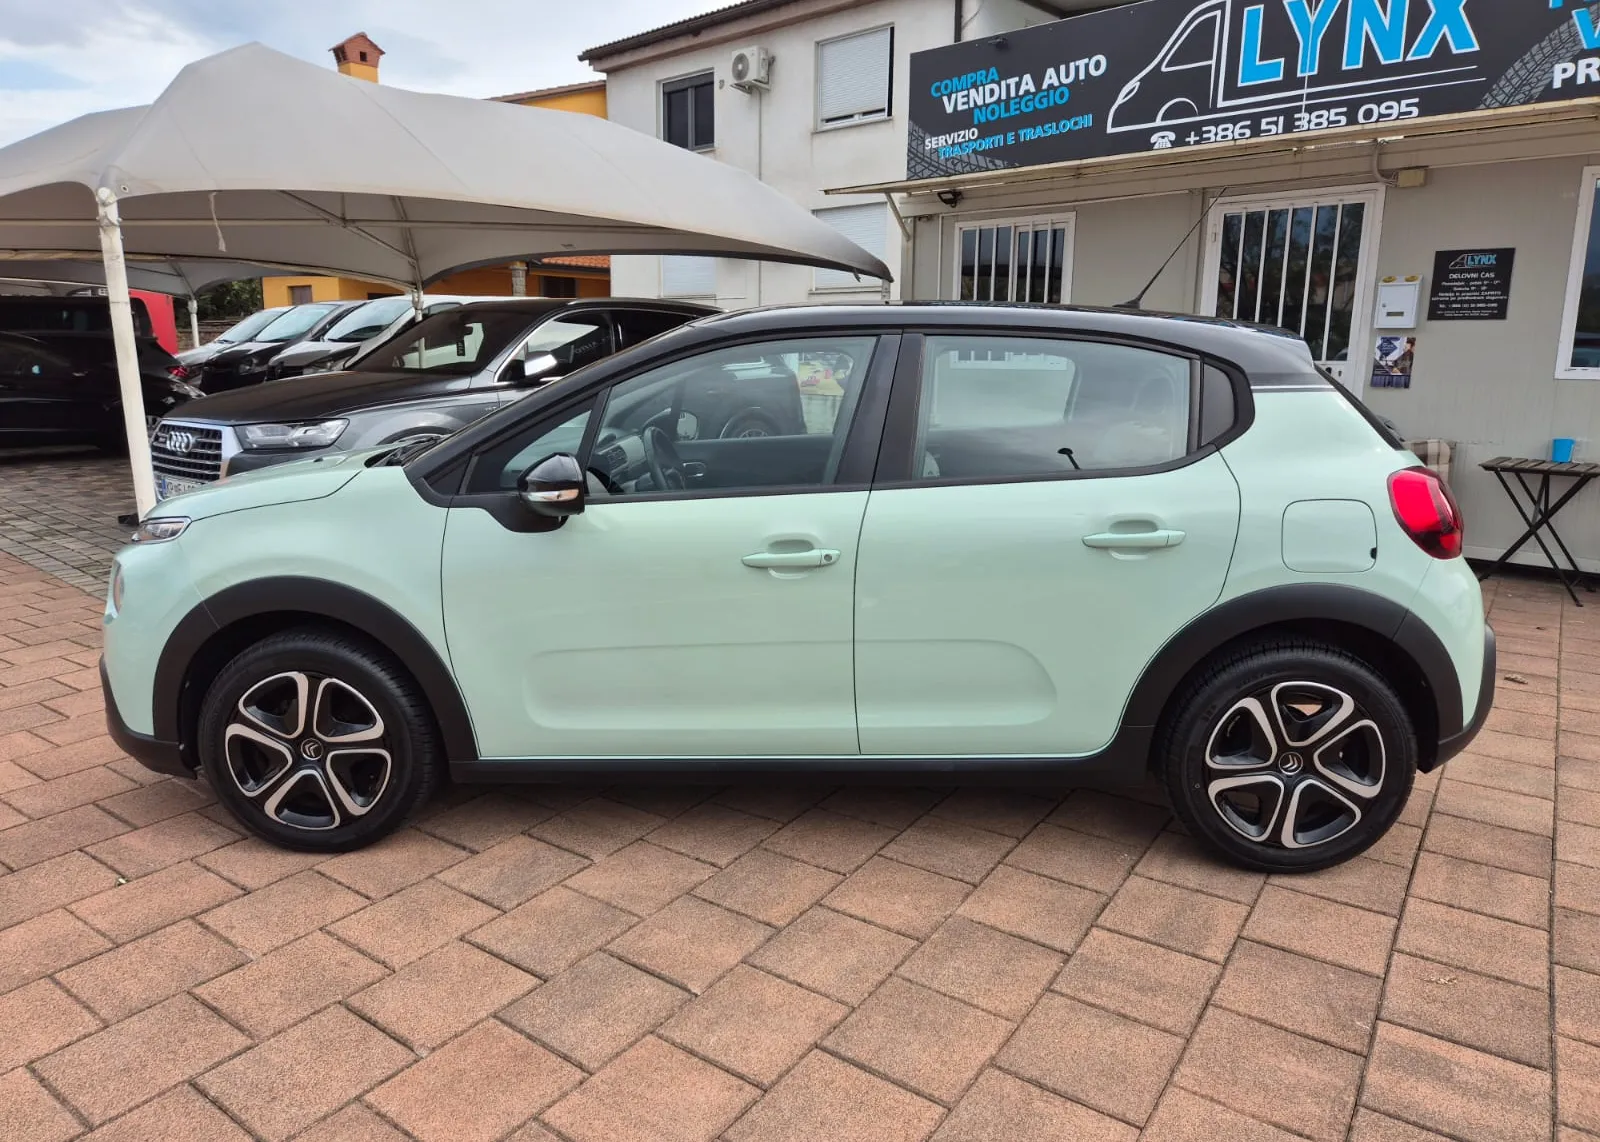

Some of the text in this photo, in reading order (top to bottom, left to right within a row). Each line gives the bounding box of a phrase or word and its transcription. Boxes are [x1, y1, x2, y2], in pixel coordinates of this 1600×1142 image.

[1238, 0, 1480, 87] LYNX
[930, 66, 999, 98] COMPRA
[942, 54, 1107, 114] VENDITA AUTO
[1552, 57, 1600, 89] PR
[973, 87, 1070, 125] NOLEGGIO
[1185, 98, 1420, 145] +386 51 385 095
[924, 127, 979, 150] SERVIZIO
[938, 114, 1093, 159] TRASPORTI E TRASLOCHI
[1467, 254, 1497, 265] LYNX
